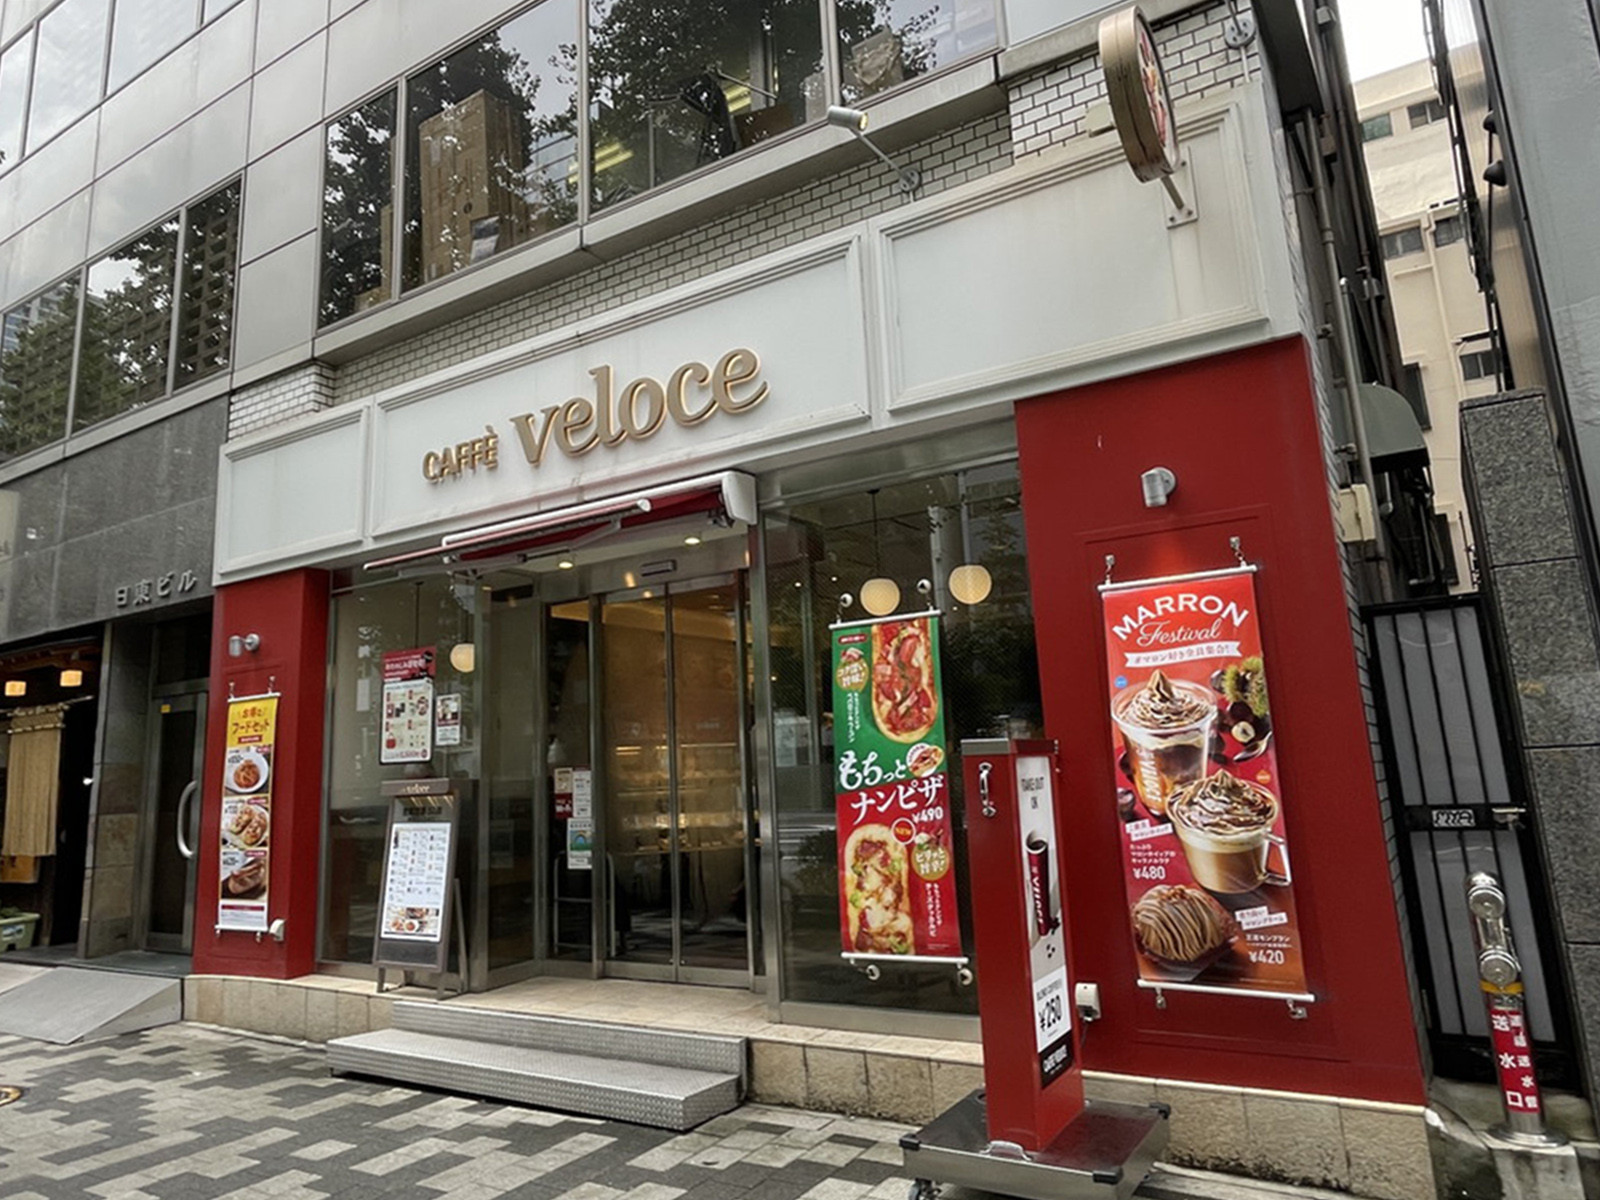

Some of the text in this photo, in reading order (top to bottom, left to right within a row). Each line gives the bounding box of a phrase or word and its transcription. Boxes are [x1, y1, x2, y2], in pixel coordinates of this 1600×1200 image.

[422, 348, 770, 484] CAFFÈ veloce
[115, 569, 198, 606] 日東ビル
[1112, 593, 1249, 641] MARRON
[1137, 618, 1222, 647] Festival
[839, 750, 906, 790] もちっと
[851, 775, 944, 825] ナンピザ
[1132, 865, 1166, 880] ¥480
[1248, 949, 1285, 965] ¥420
[1492, 1013, 1523, 1108] 送水口
